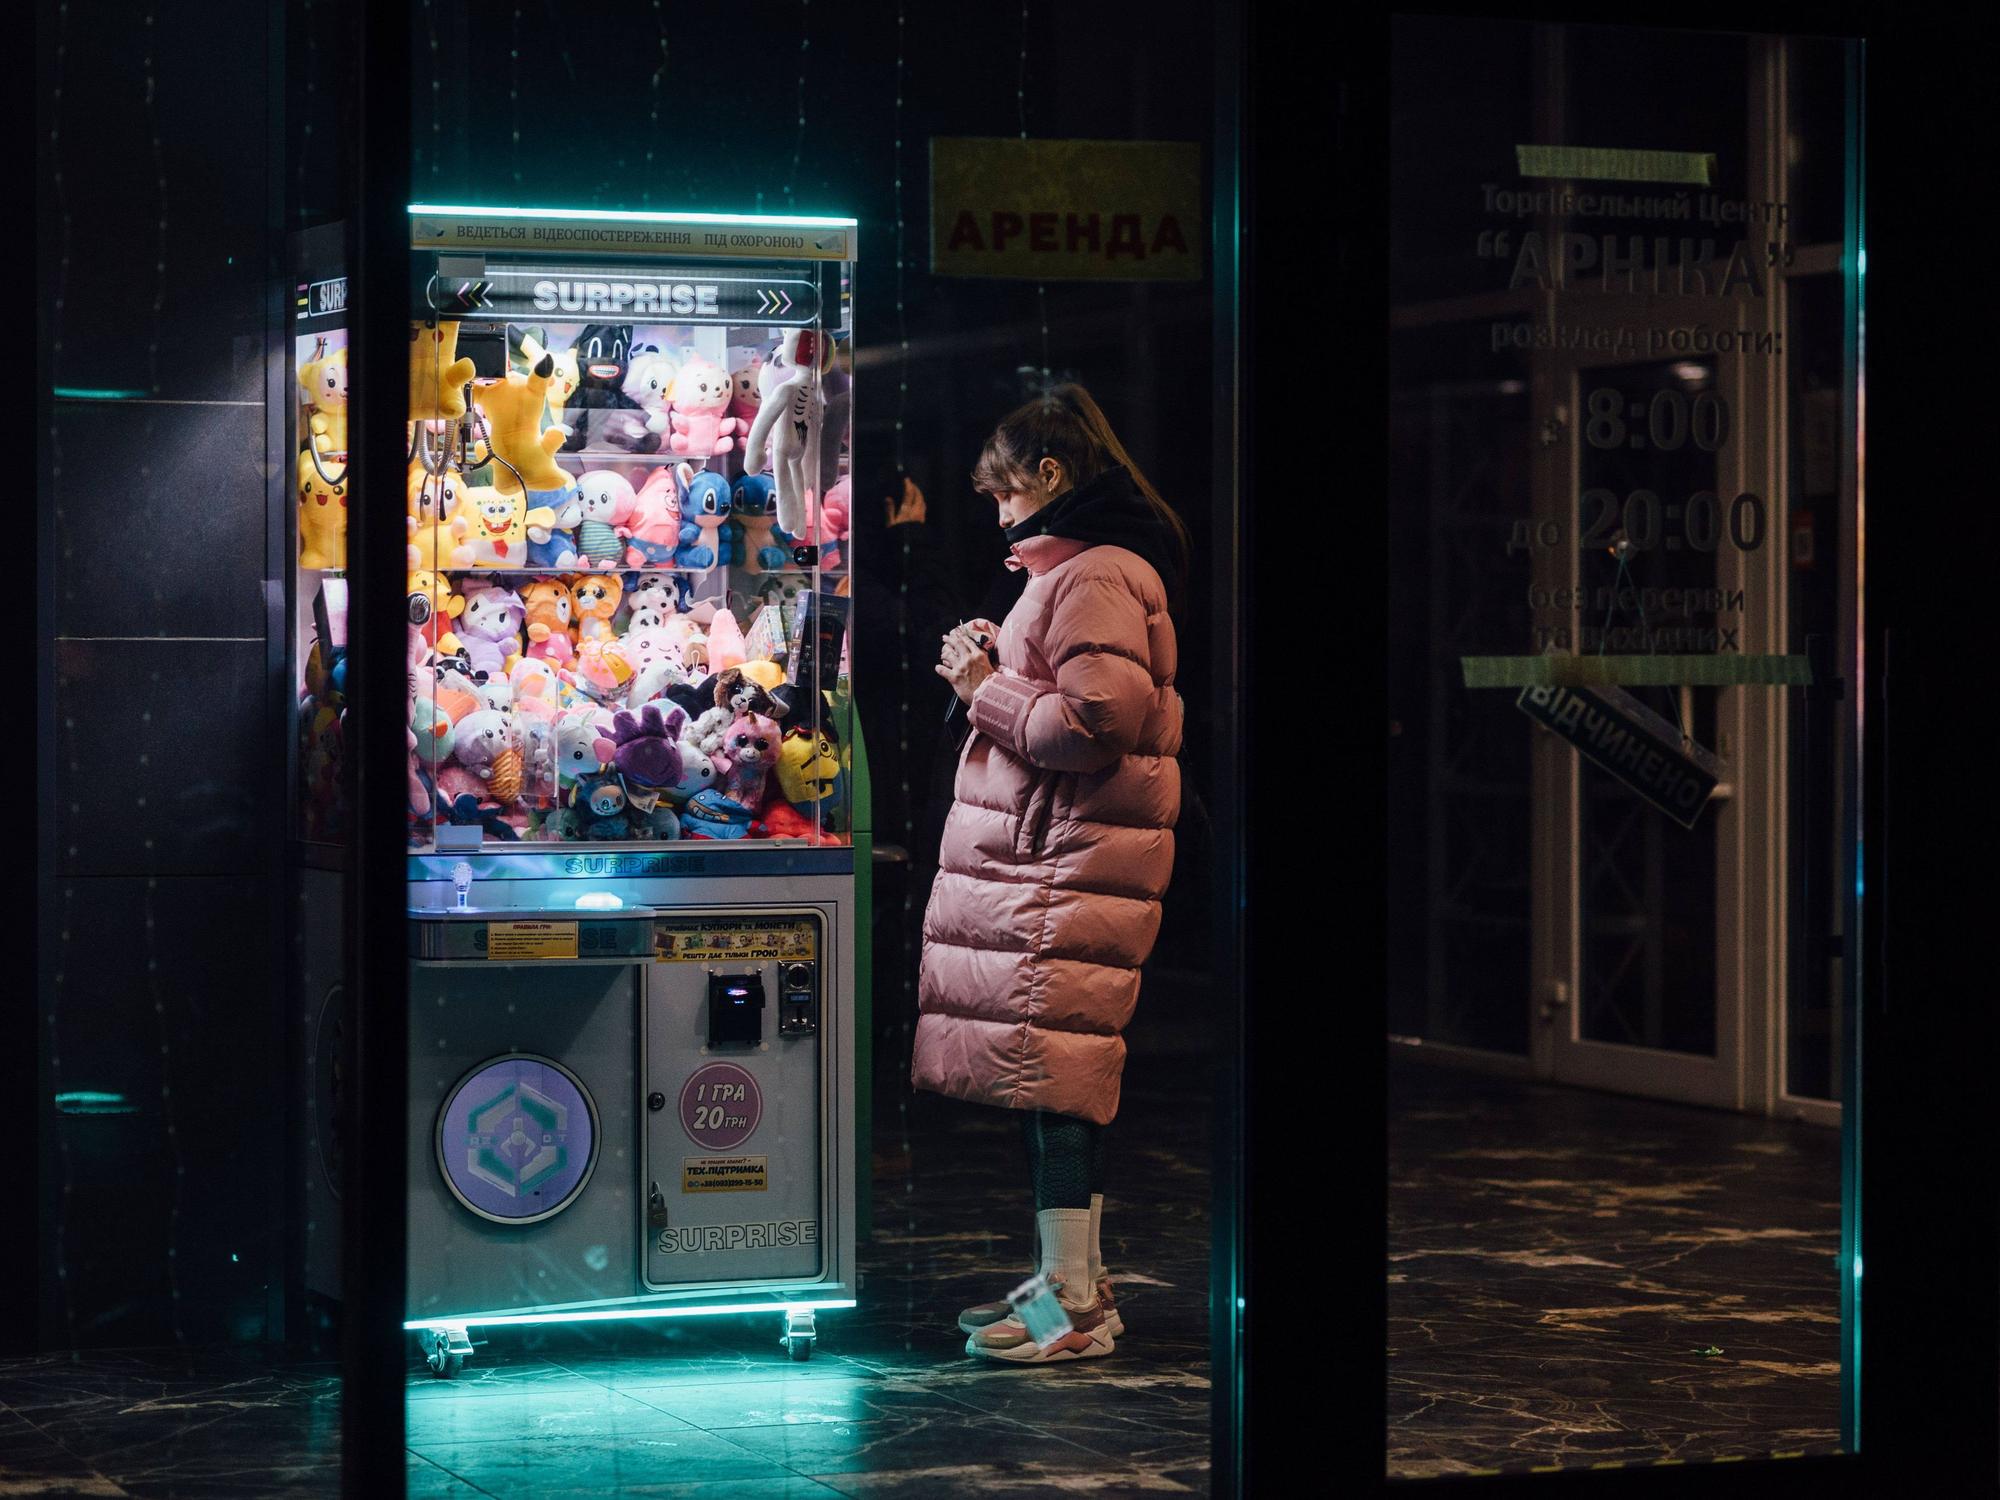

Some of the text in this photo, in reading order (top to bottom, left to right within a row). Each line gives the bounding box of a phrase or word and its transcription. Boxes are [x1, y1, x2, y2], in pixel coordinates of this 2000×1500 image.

[457, 225, 804, 249] ВЕДЕТЬСЯ ВІДЕОСПОСТЕРЕЖЕННЯ ПІД ОХОРОНОЮ
[949, 210, 1188, 260] АРЕНДА
[320, 280, 348, 311] SURP
[533, 281, 719, 315] SURPRISE
[1648, 323, 1783, 355] роботи:
[1586, 387, 1730, 452] 8:00
[1506, 488, 1766, 557] до 20:00
[1529, 685, 1701, 808] ВІДЧИНЕНО
[565, 855, 704, 873] SURPRISE
[754, 921, 795, 930] МОНЕТИ
[751, 949, 778, 958] ГРОЮ
[697, 1084, 745, 1101] 1 ГРА
[659, 1220, 817, 1254] SURPRISE
